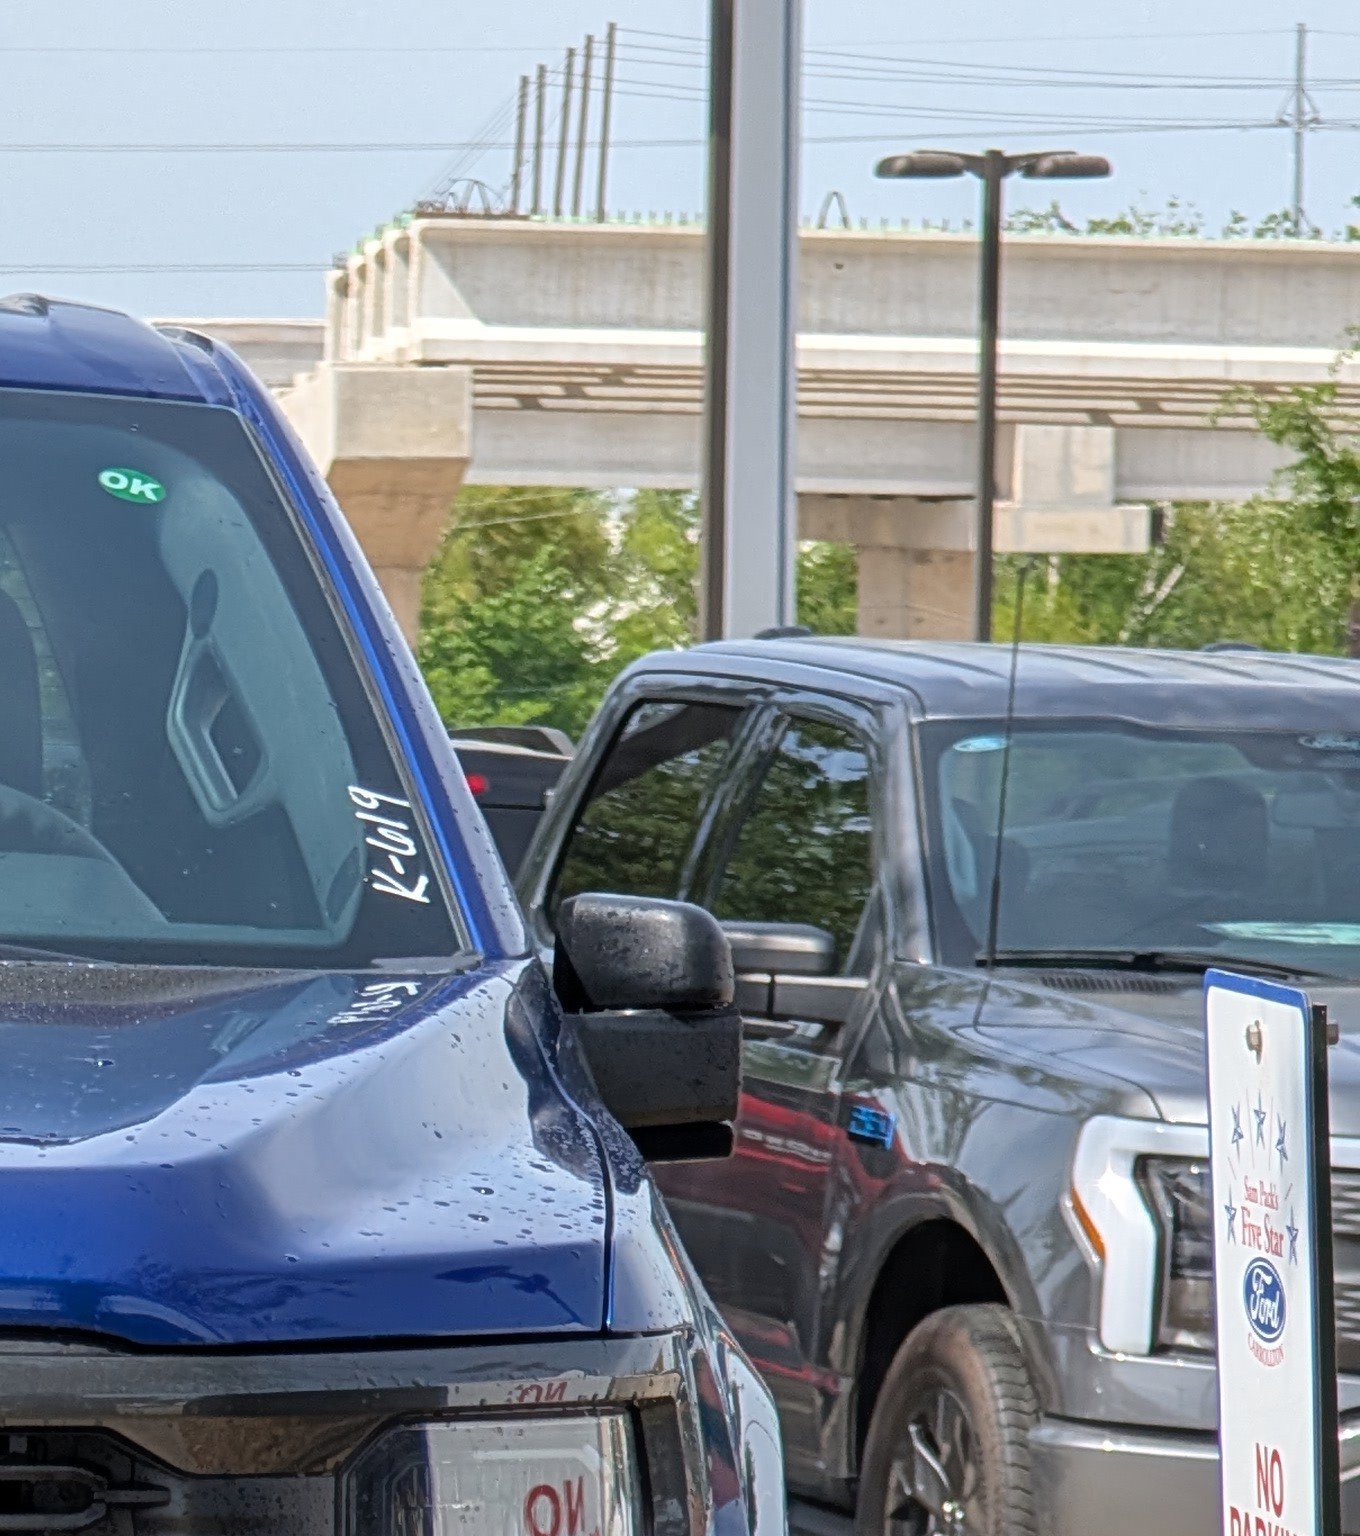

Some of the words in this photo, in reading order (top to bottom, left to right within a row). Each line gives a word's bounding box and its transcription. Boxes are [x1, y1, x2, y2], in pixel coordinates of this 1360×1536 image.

[99, 471, 161, 502] OK
[1241, 1205, 1262, 1251] Five
[1264, 1213, 1284, 1257] Star
[1250, 1267, 1281, 1329] Ford
[1256, 1443, 1284, 1518] NO
